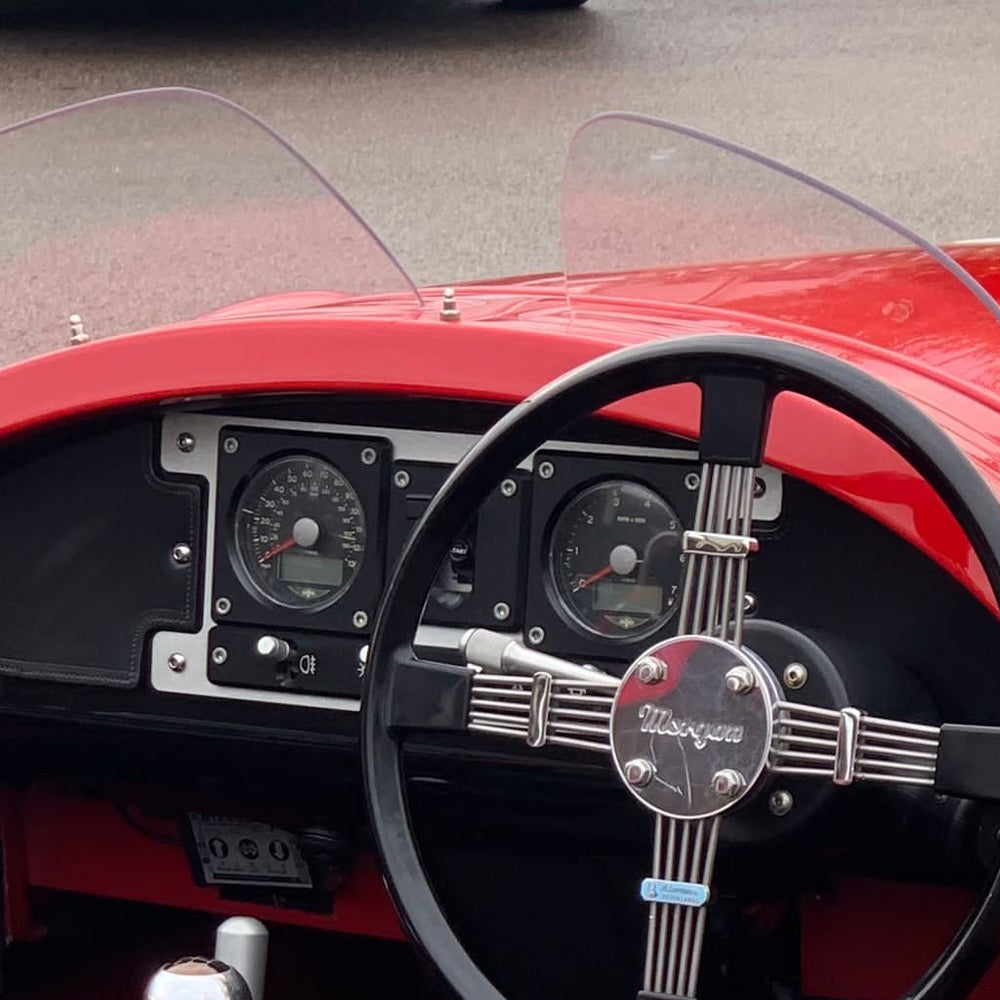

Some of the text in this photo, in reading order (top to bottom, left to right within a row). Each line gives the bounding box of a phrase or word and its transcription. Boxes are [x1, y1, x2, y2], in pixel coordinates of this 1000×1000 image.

[302, 470, 313, 478] 60
[273, 486, 285, 494] 40
[260, 517, 270, 525] 20
[587, 515, 594, 524] 2
[669, 521, 677, 530] 5
[671, 585, 678, 594] 7
[638, 703, 744, 750] Morgan
